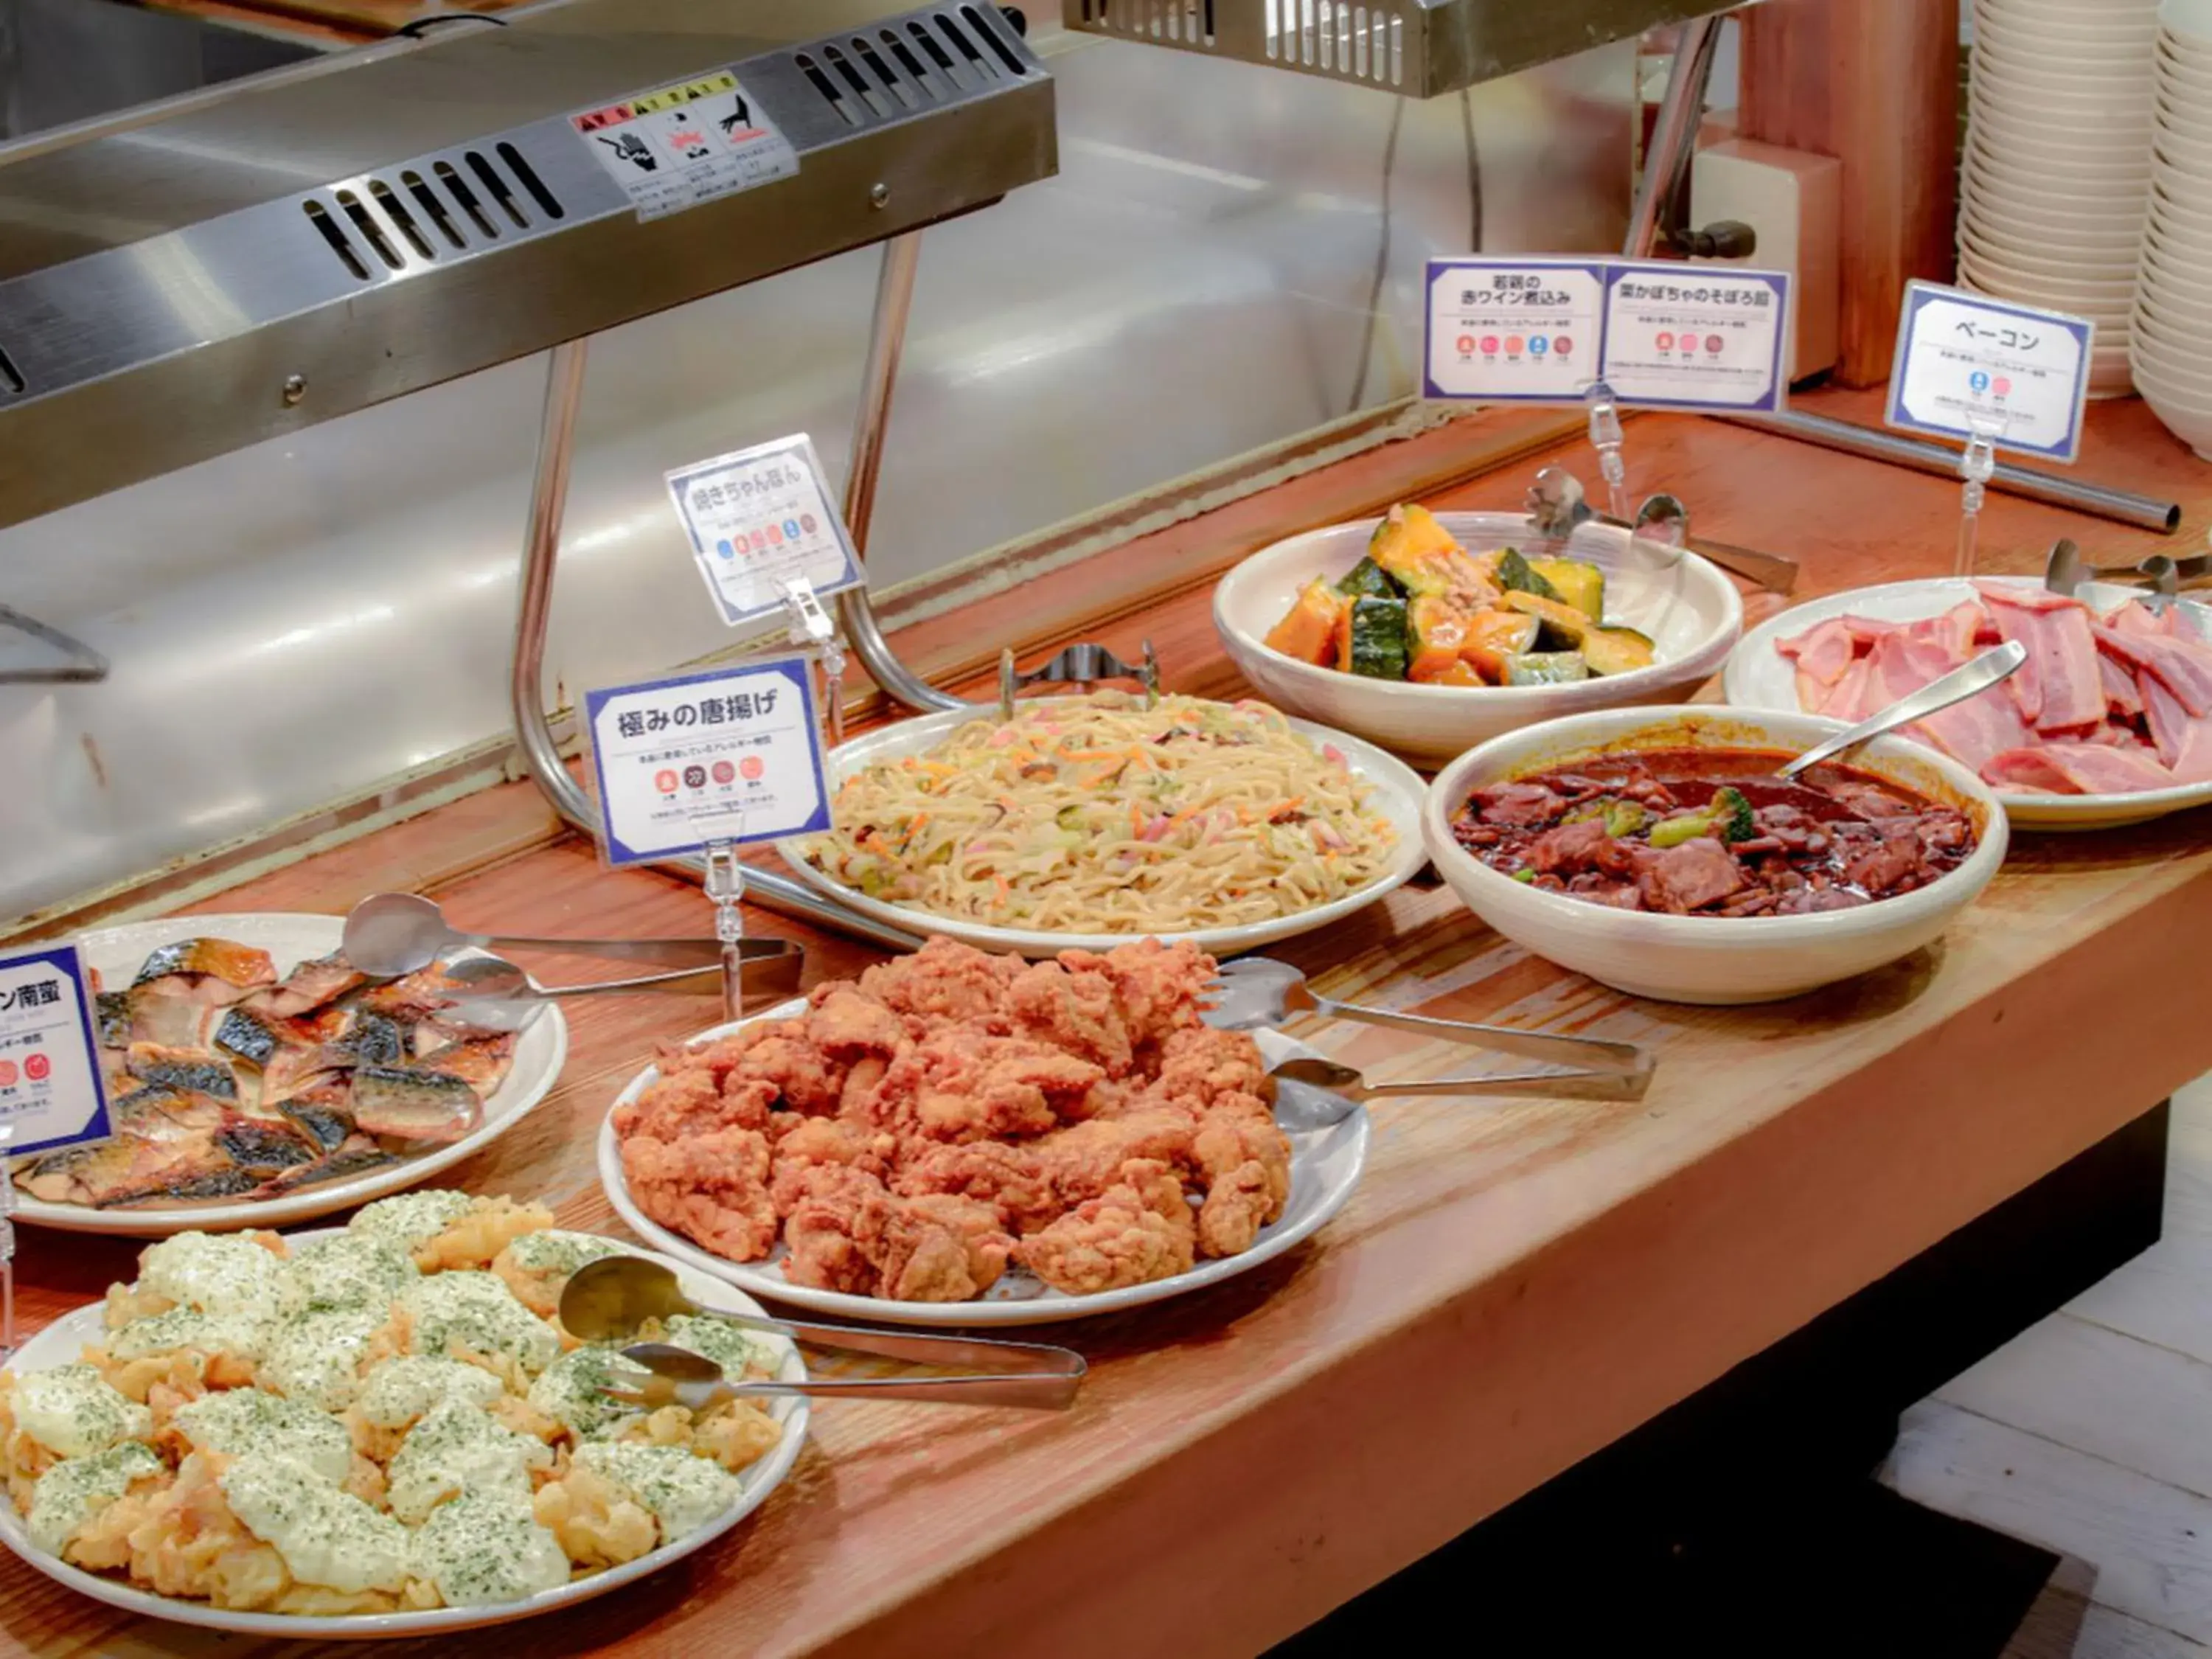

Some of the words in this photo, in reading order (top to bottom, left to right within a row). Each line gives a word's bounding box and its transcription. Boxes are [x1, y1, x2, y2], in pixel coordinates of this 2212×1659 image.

[1955, 321, 2040, 350] ベーコン
[617, 688, 778, 740] 極みの唐揚げ
